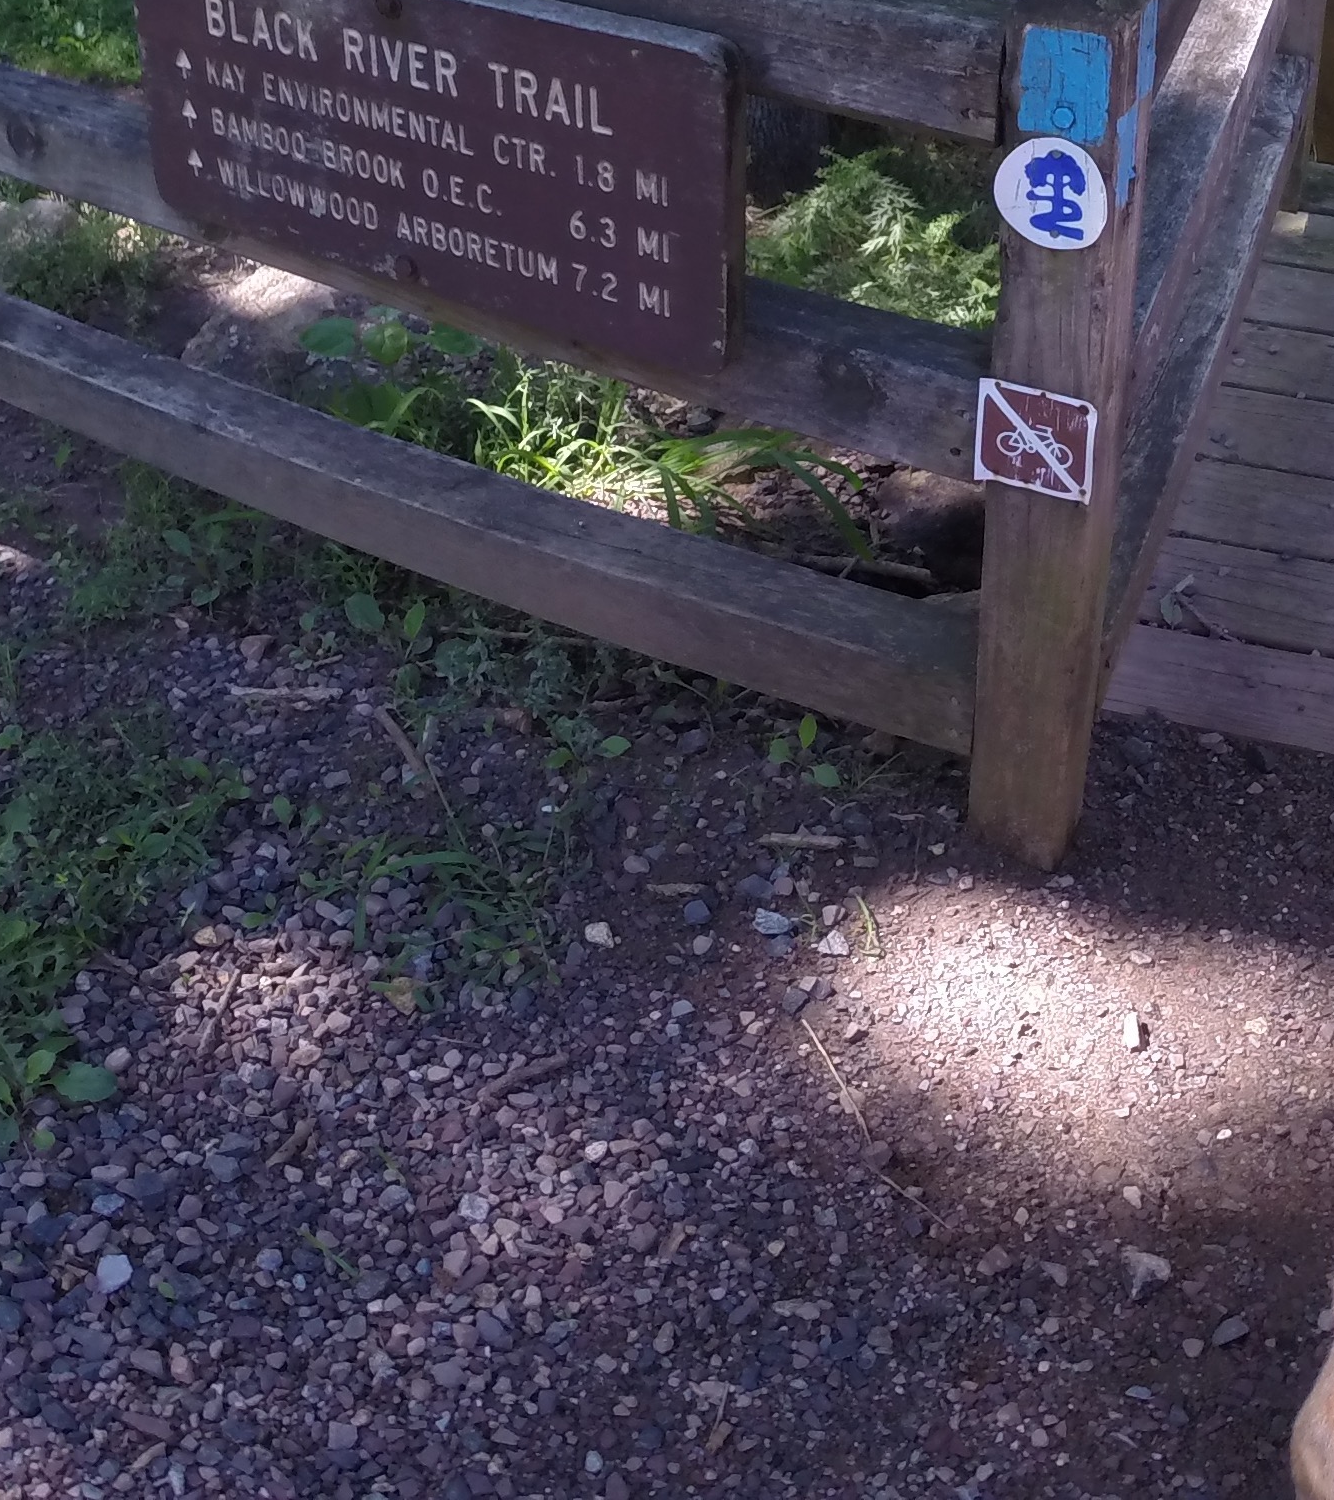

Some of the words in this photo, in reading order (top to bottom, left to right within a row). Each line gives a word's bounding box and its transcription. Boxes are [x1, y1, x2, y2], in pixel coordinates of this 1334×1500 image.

[205, 56, 246, 94] KAY
[262, 71, 474, 156] ENVIRONMENTAL
[493, 132, 556, 177] CTR.
[575, 154, 615, 193] 1.8
[635, 168, 669, 207] MI
[342, 27, 459, 98] RIVER
[487, 61, 614, 136] TRAIL
[211, 107, 307, 160] BAMBOO
[322, 140, 406, 190] BROOK
[422, 167, 502, 216] O.E.C.
[569, 210, 617, 248] 6.3
[636, 226, 670, 264] MI
[217, 157, 379, 231] WILLOWWOOD
[396, 212, 559, 285] ARBORETUM
[571, 262, 618, 303] 7.2
[638, 281, 671, 318] MI
